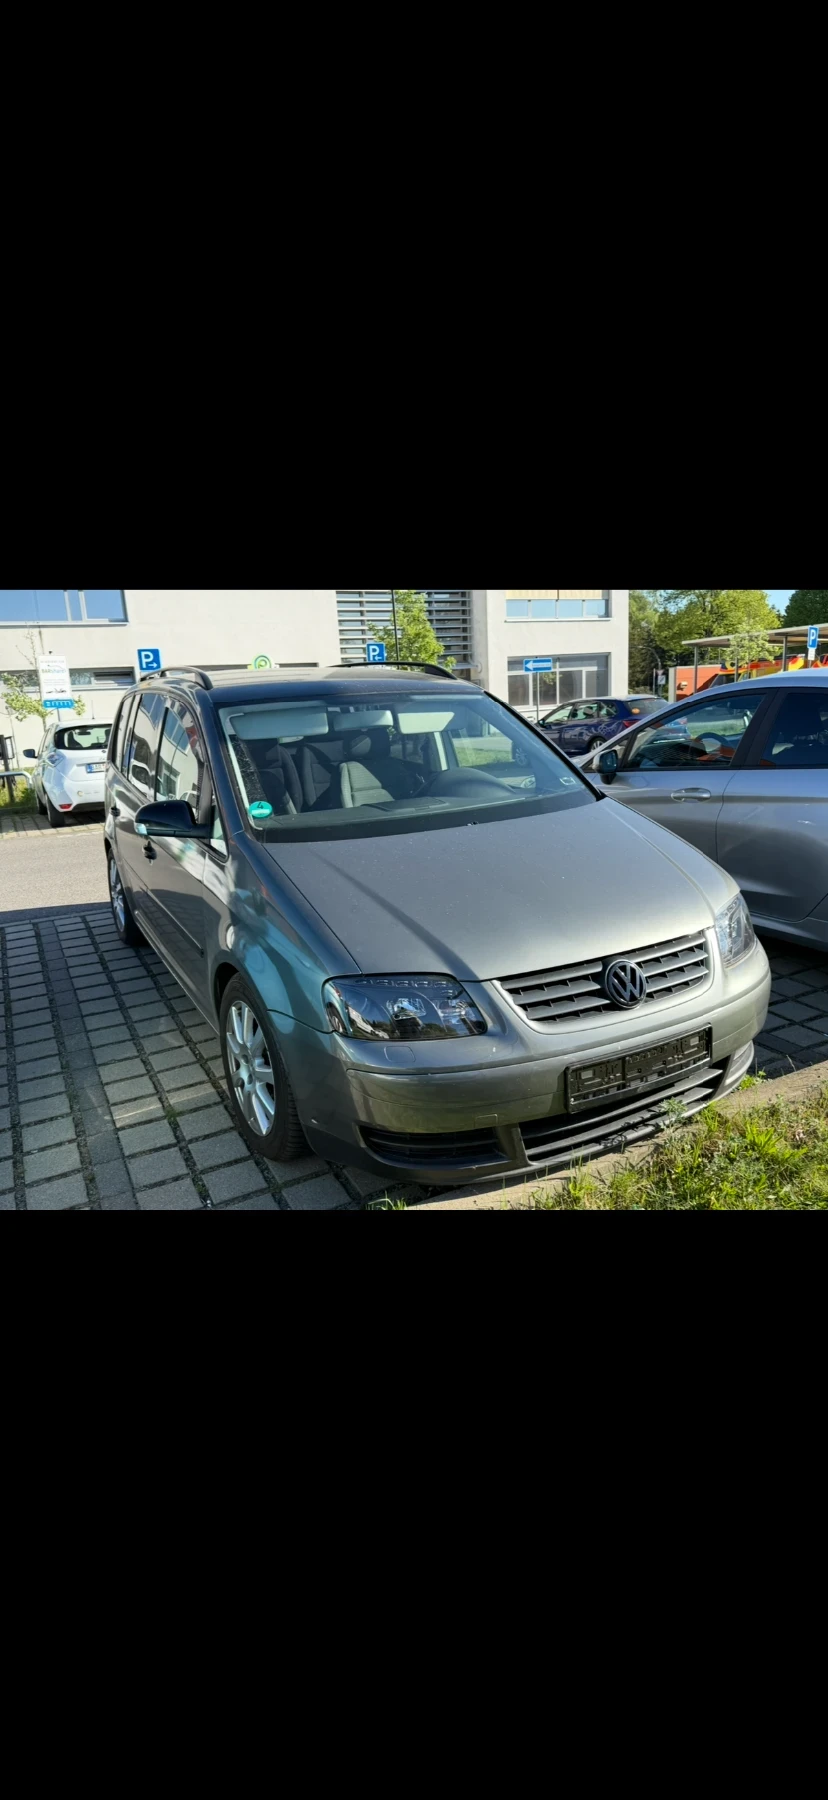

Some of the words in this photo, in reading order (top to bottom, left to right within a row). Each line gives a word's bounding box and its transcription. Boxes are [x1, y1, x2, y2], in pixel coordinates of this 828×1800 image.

[809, 628, 816, 645] P
[141, 651, 154, 668] P
[369, 645, 379, 661] P
